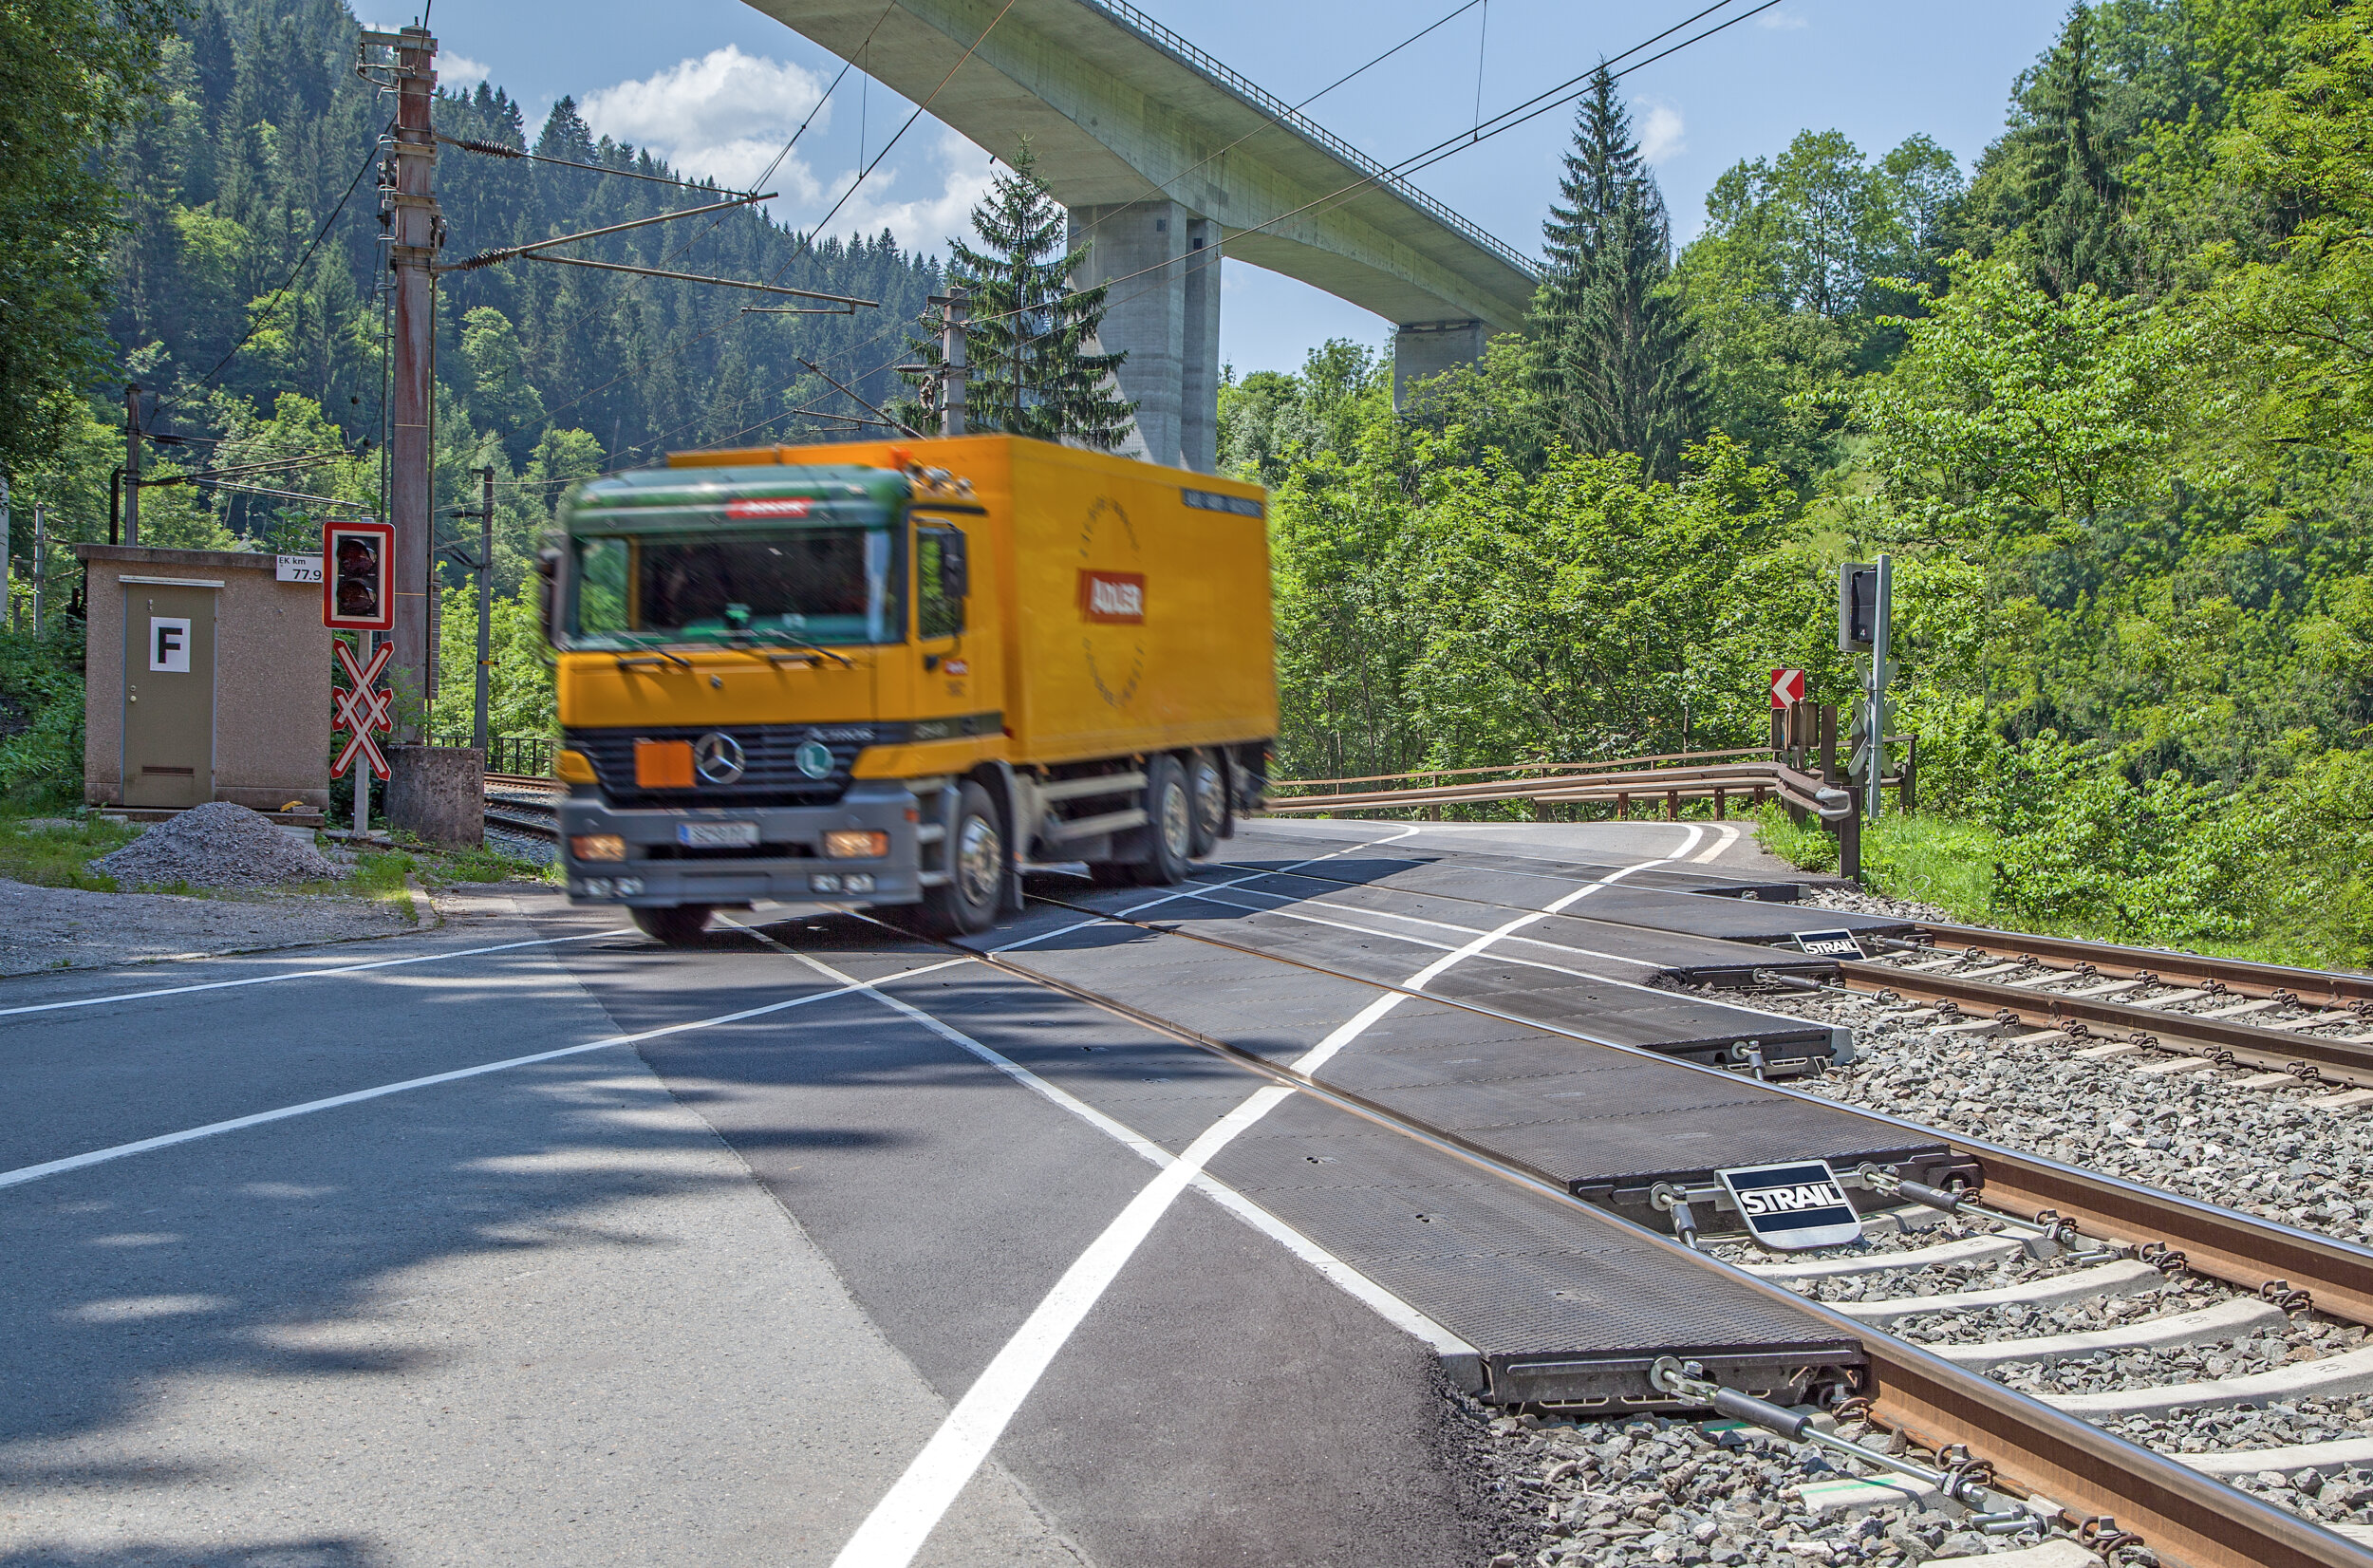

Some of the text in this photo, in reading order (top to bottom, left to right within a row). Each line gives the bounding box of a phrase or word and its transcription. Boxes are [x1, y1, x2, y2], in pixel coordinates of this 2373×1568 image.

[292, 569, 323, 581] 77.9
[158, 626, 183, 663] F
[1804, 941, 1859, 955] STRAIL
[1740, 1183, 1847, 1214] STRAIL
